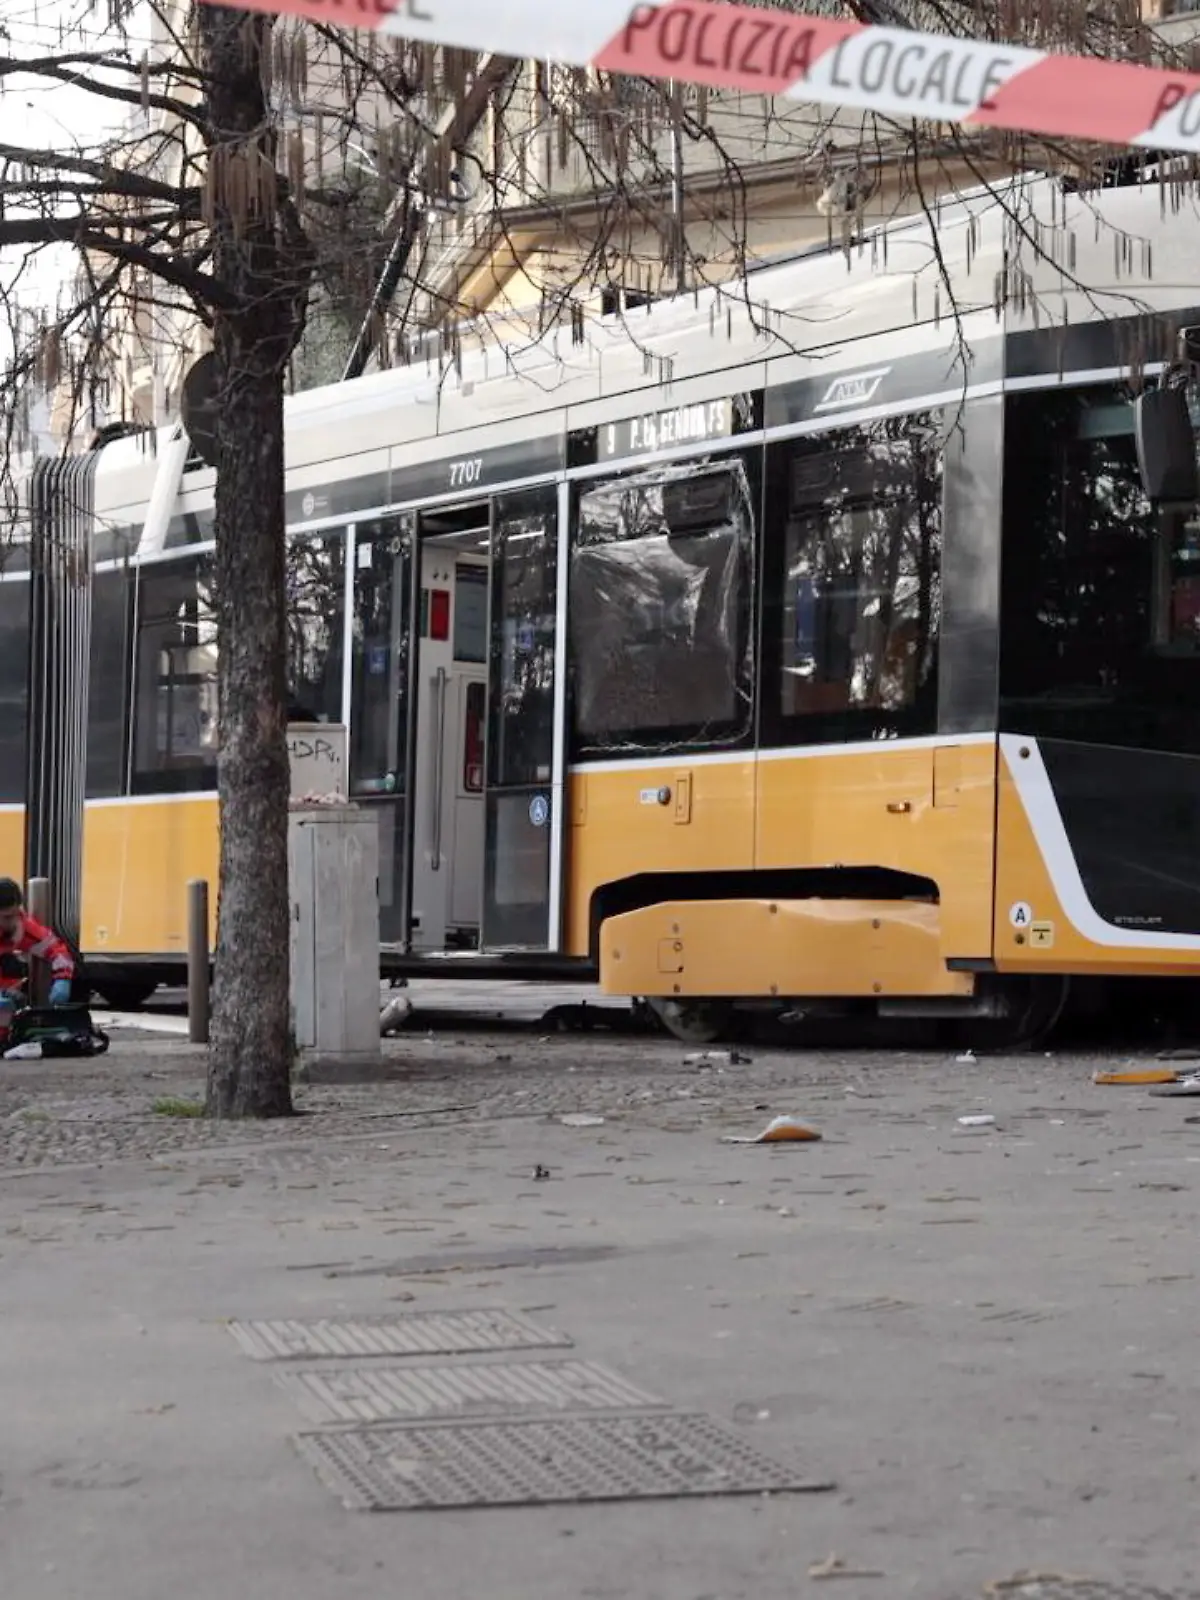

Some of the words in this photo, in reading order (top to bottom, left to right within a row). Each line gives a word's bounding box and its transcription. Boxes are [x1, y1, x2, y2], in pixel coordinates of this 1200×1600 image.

[623, 3, 816, 81] POLIZIA
[831, 34, 1013, 110] LOCALE
[449, 459, 482, 486] 7707
